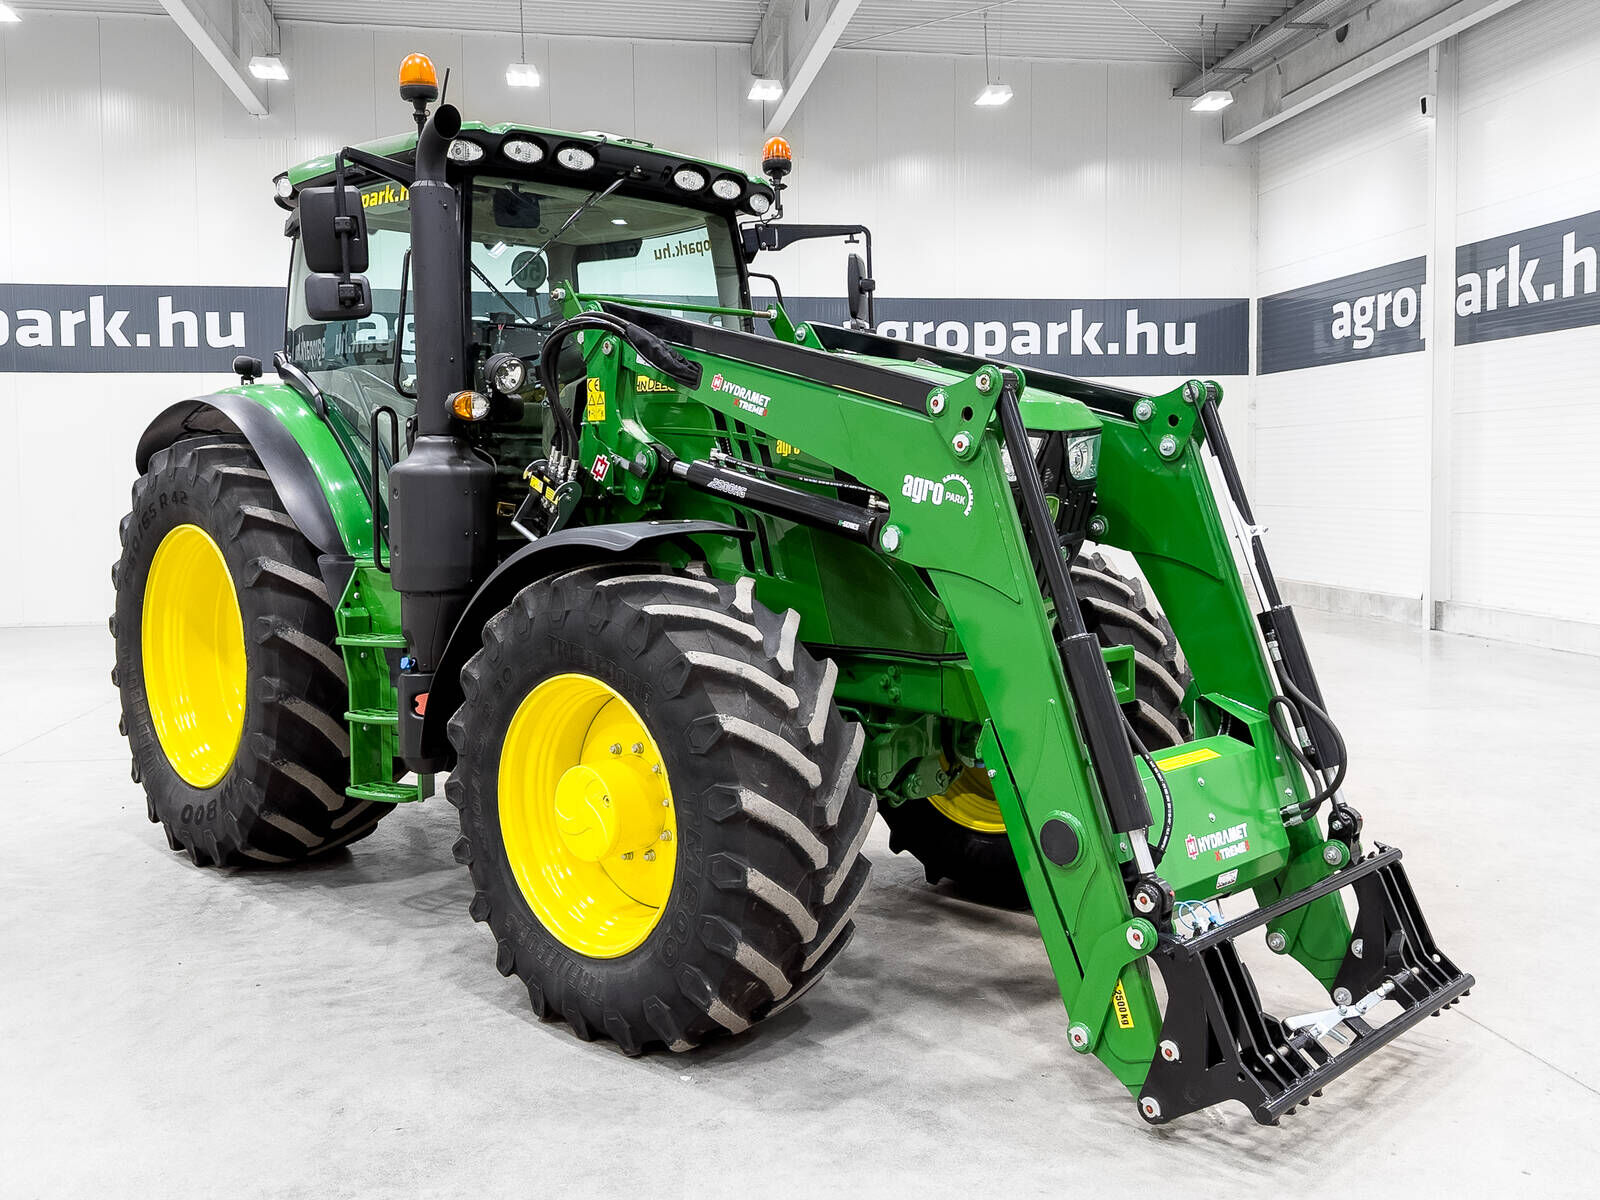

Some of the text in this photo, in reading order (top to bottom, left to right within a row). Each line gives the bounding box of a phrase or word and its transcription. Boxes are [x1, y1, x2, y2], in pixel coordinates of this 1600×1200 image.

[0, 295, 246, 348] ark.hu
[722, 380, 771, 408] HYDRAMET
[902, 474, 944, 505] agro
[945, 491, 967, 506] PARK
[1198, 823, 1248, 853] HYDRAMET
[1113, 989, 1130, 1026] 2500 kg
